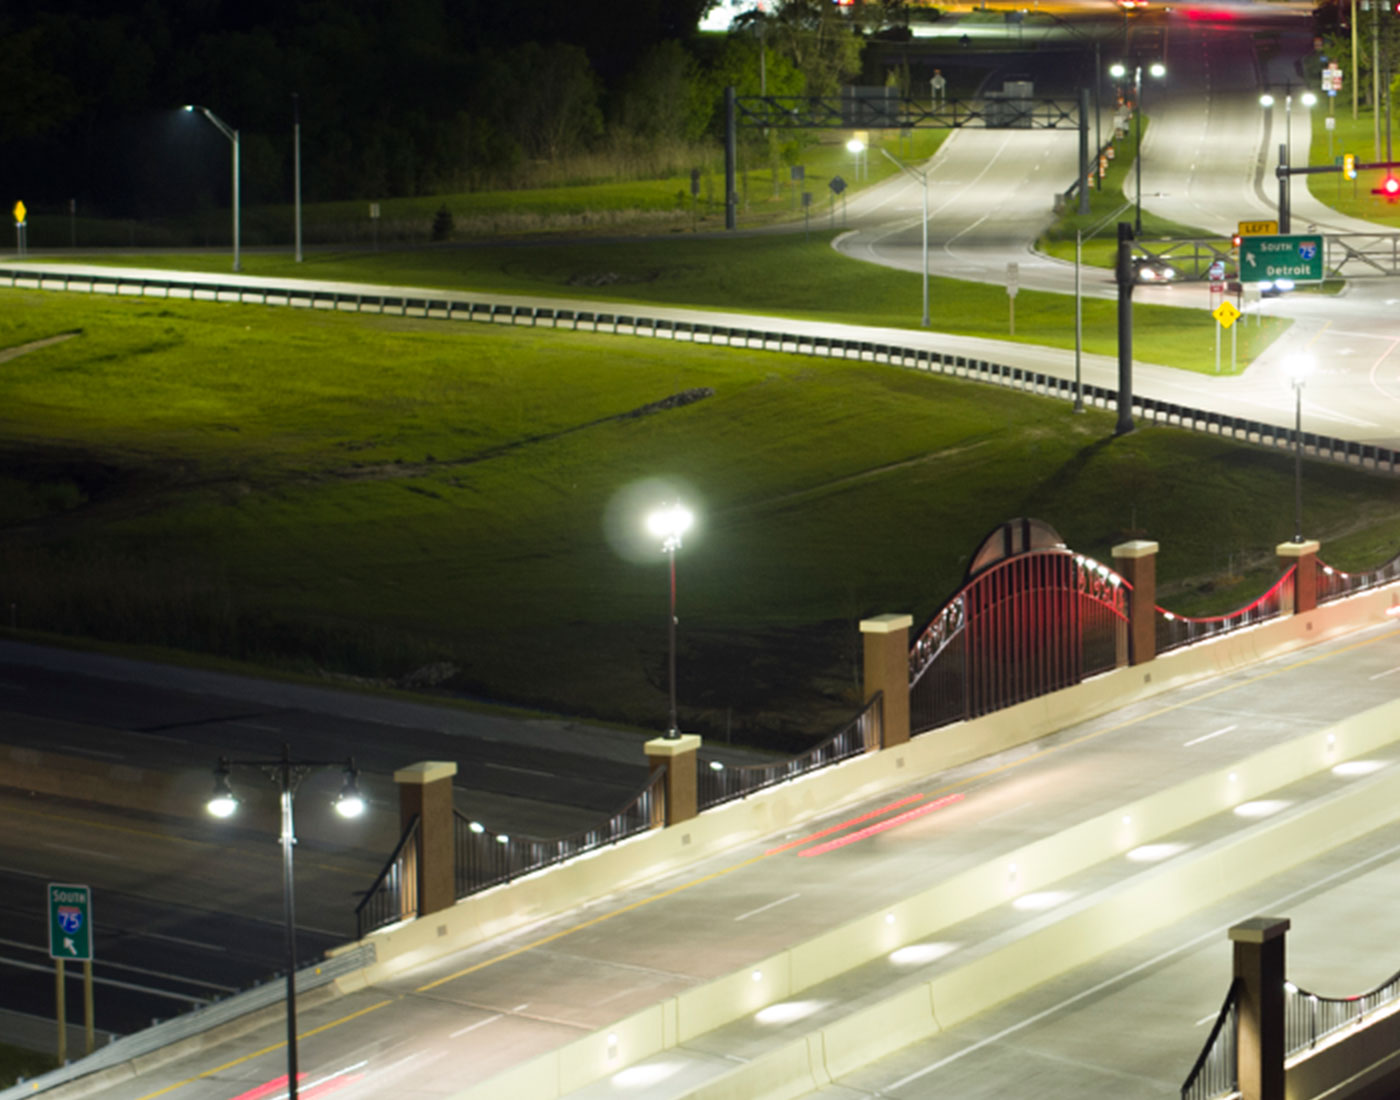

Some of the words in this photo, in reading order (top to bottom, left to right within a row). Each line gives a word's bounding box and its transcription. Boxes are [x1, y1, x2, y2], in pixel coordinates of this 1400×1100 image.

[1245, 224, 1270, 233] LEFT
[1260, 242, 1293, 252] SOUTH
[1300, 247, 1316, 258] 75
[1266, 265, 1311, 276] Detroit
[53, 889, 86, 902] SOUTH
[61, 912, 80, 929] 75
